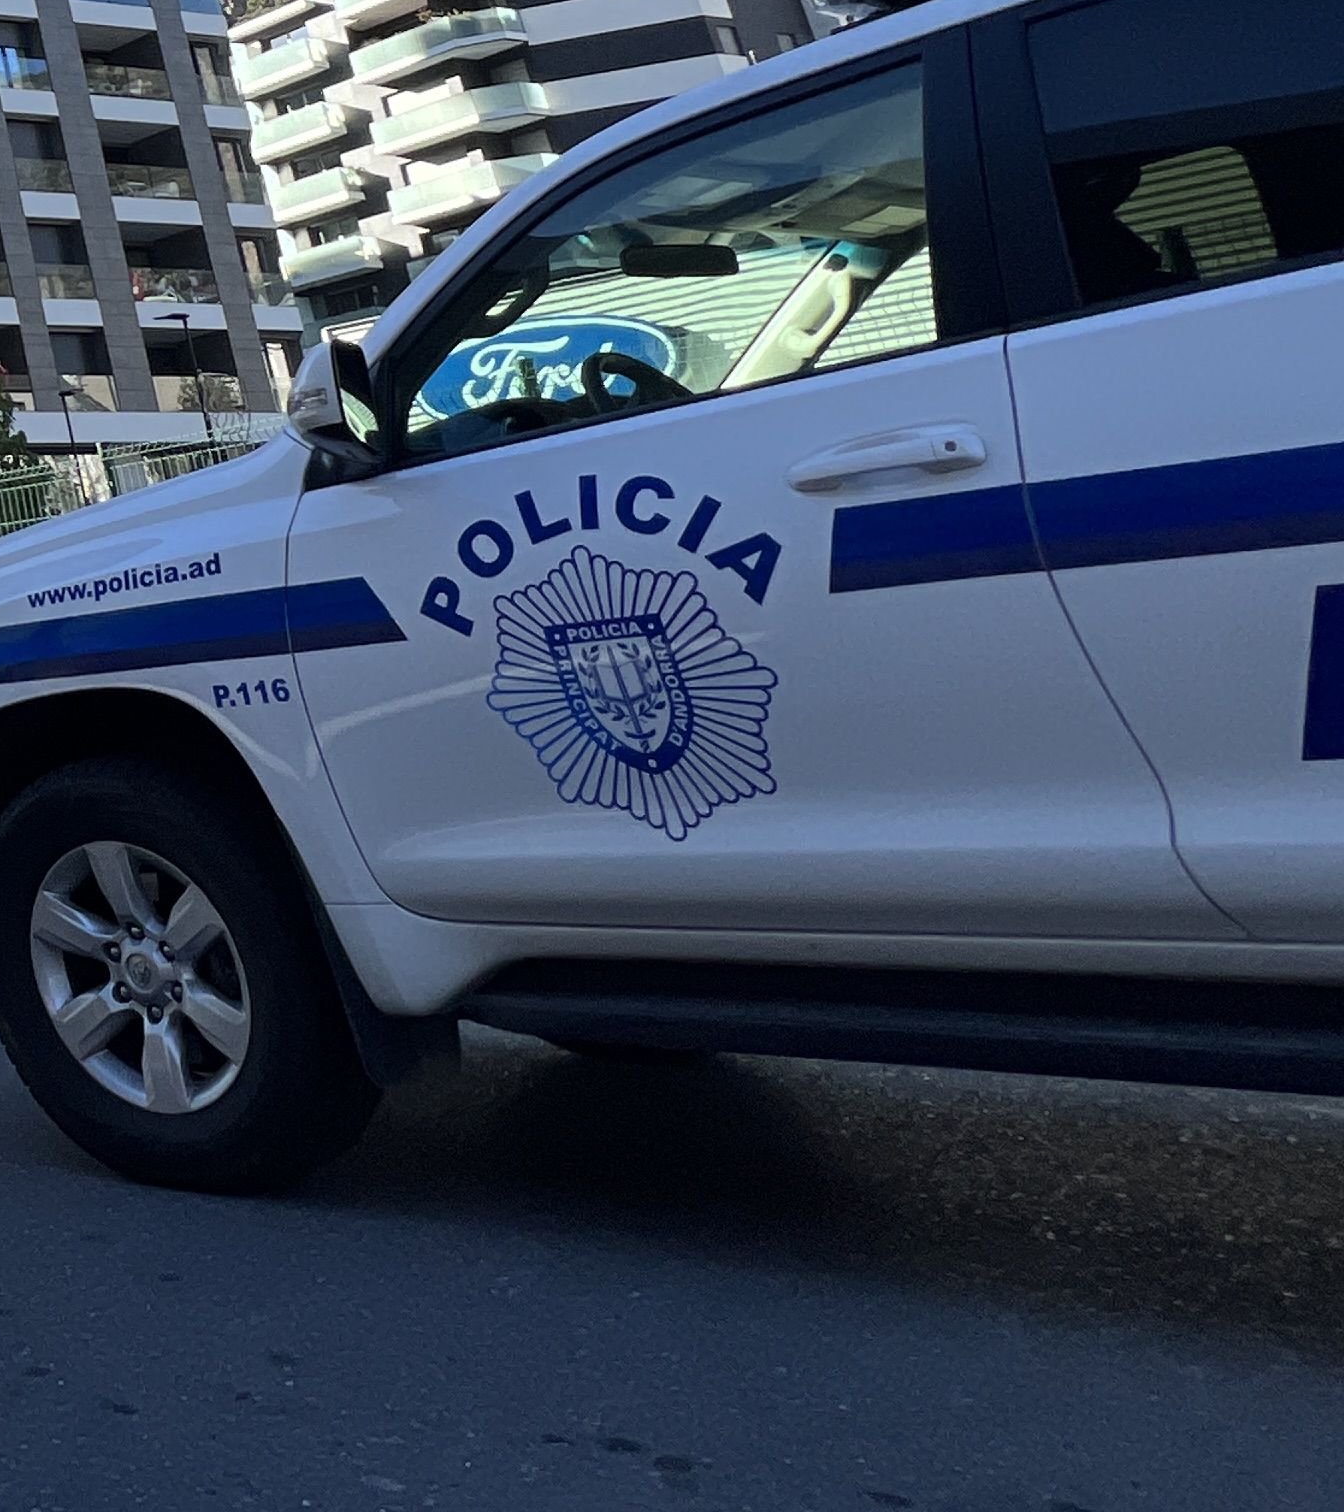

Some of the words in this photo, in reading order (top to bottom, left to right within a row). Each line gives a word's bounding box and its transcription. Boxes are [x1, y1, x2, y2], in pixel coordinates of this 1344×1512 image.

[419, 474, 782, 638] POLICIA
[27, 552, 222, 608] www.policia.ad
[566, 622, 642, 641] POLICIA
[212, 678, 291, 708] P.116
